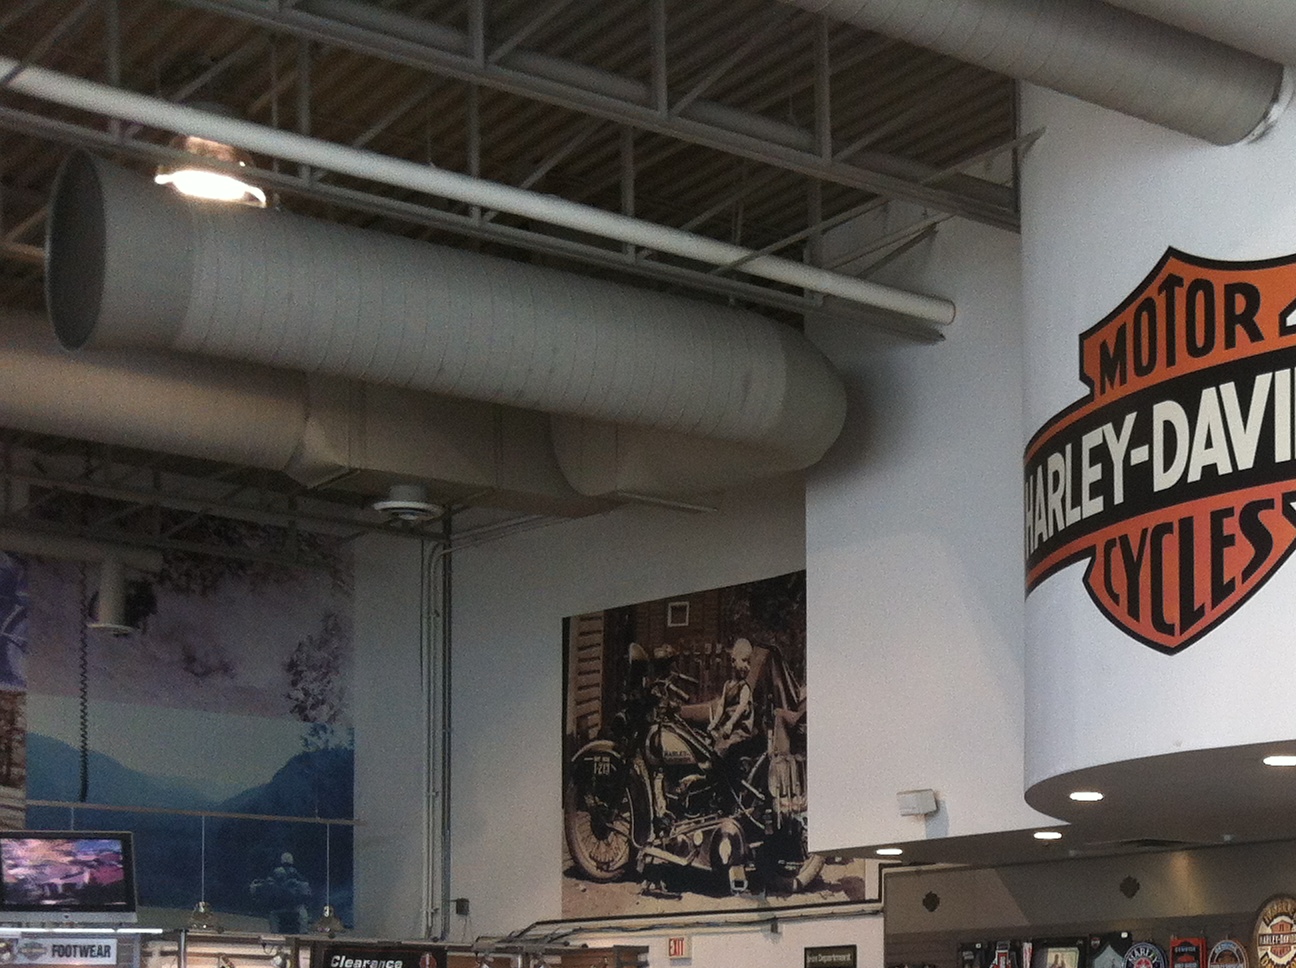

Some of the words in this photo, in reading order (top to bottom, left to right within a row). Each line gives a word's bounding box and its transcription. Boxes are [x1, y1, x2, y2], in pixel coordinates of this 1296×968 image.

[1100, 273, 1265, 396] MOTOR
[1103, 497, 1276, 638] CYCLES
[52, 944, 111, 958] FOOTWEAR
[668, 937, 685, 957] EXIT
